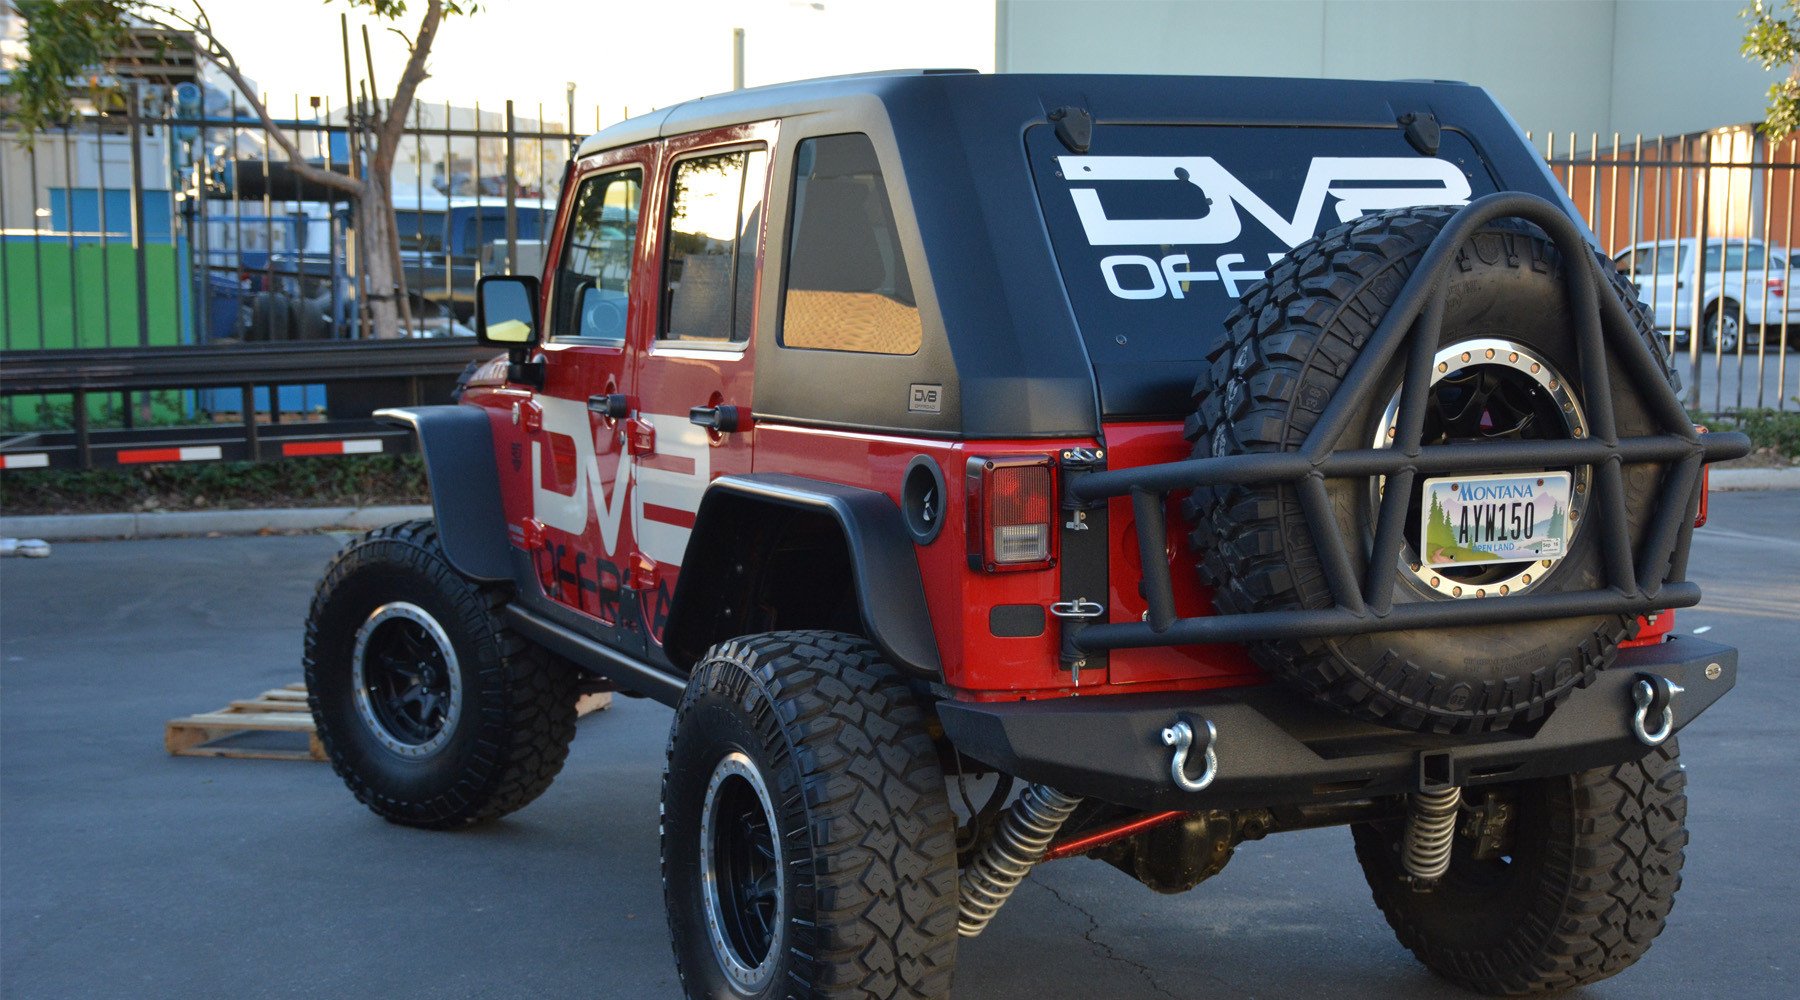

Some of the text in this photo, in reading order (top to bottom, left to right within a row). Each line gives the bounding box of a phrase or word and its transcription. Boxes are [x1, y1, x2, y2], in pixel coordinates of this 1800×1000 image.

[914, 389, 937, 403] DV8
[531, 394, 710, 567] DV8
[1459, 502, 1535, 544] AYW150
[1493, 543, 1515, 552] LAND
